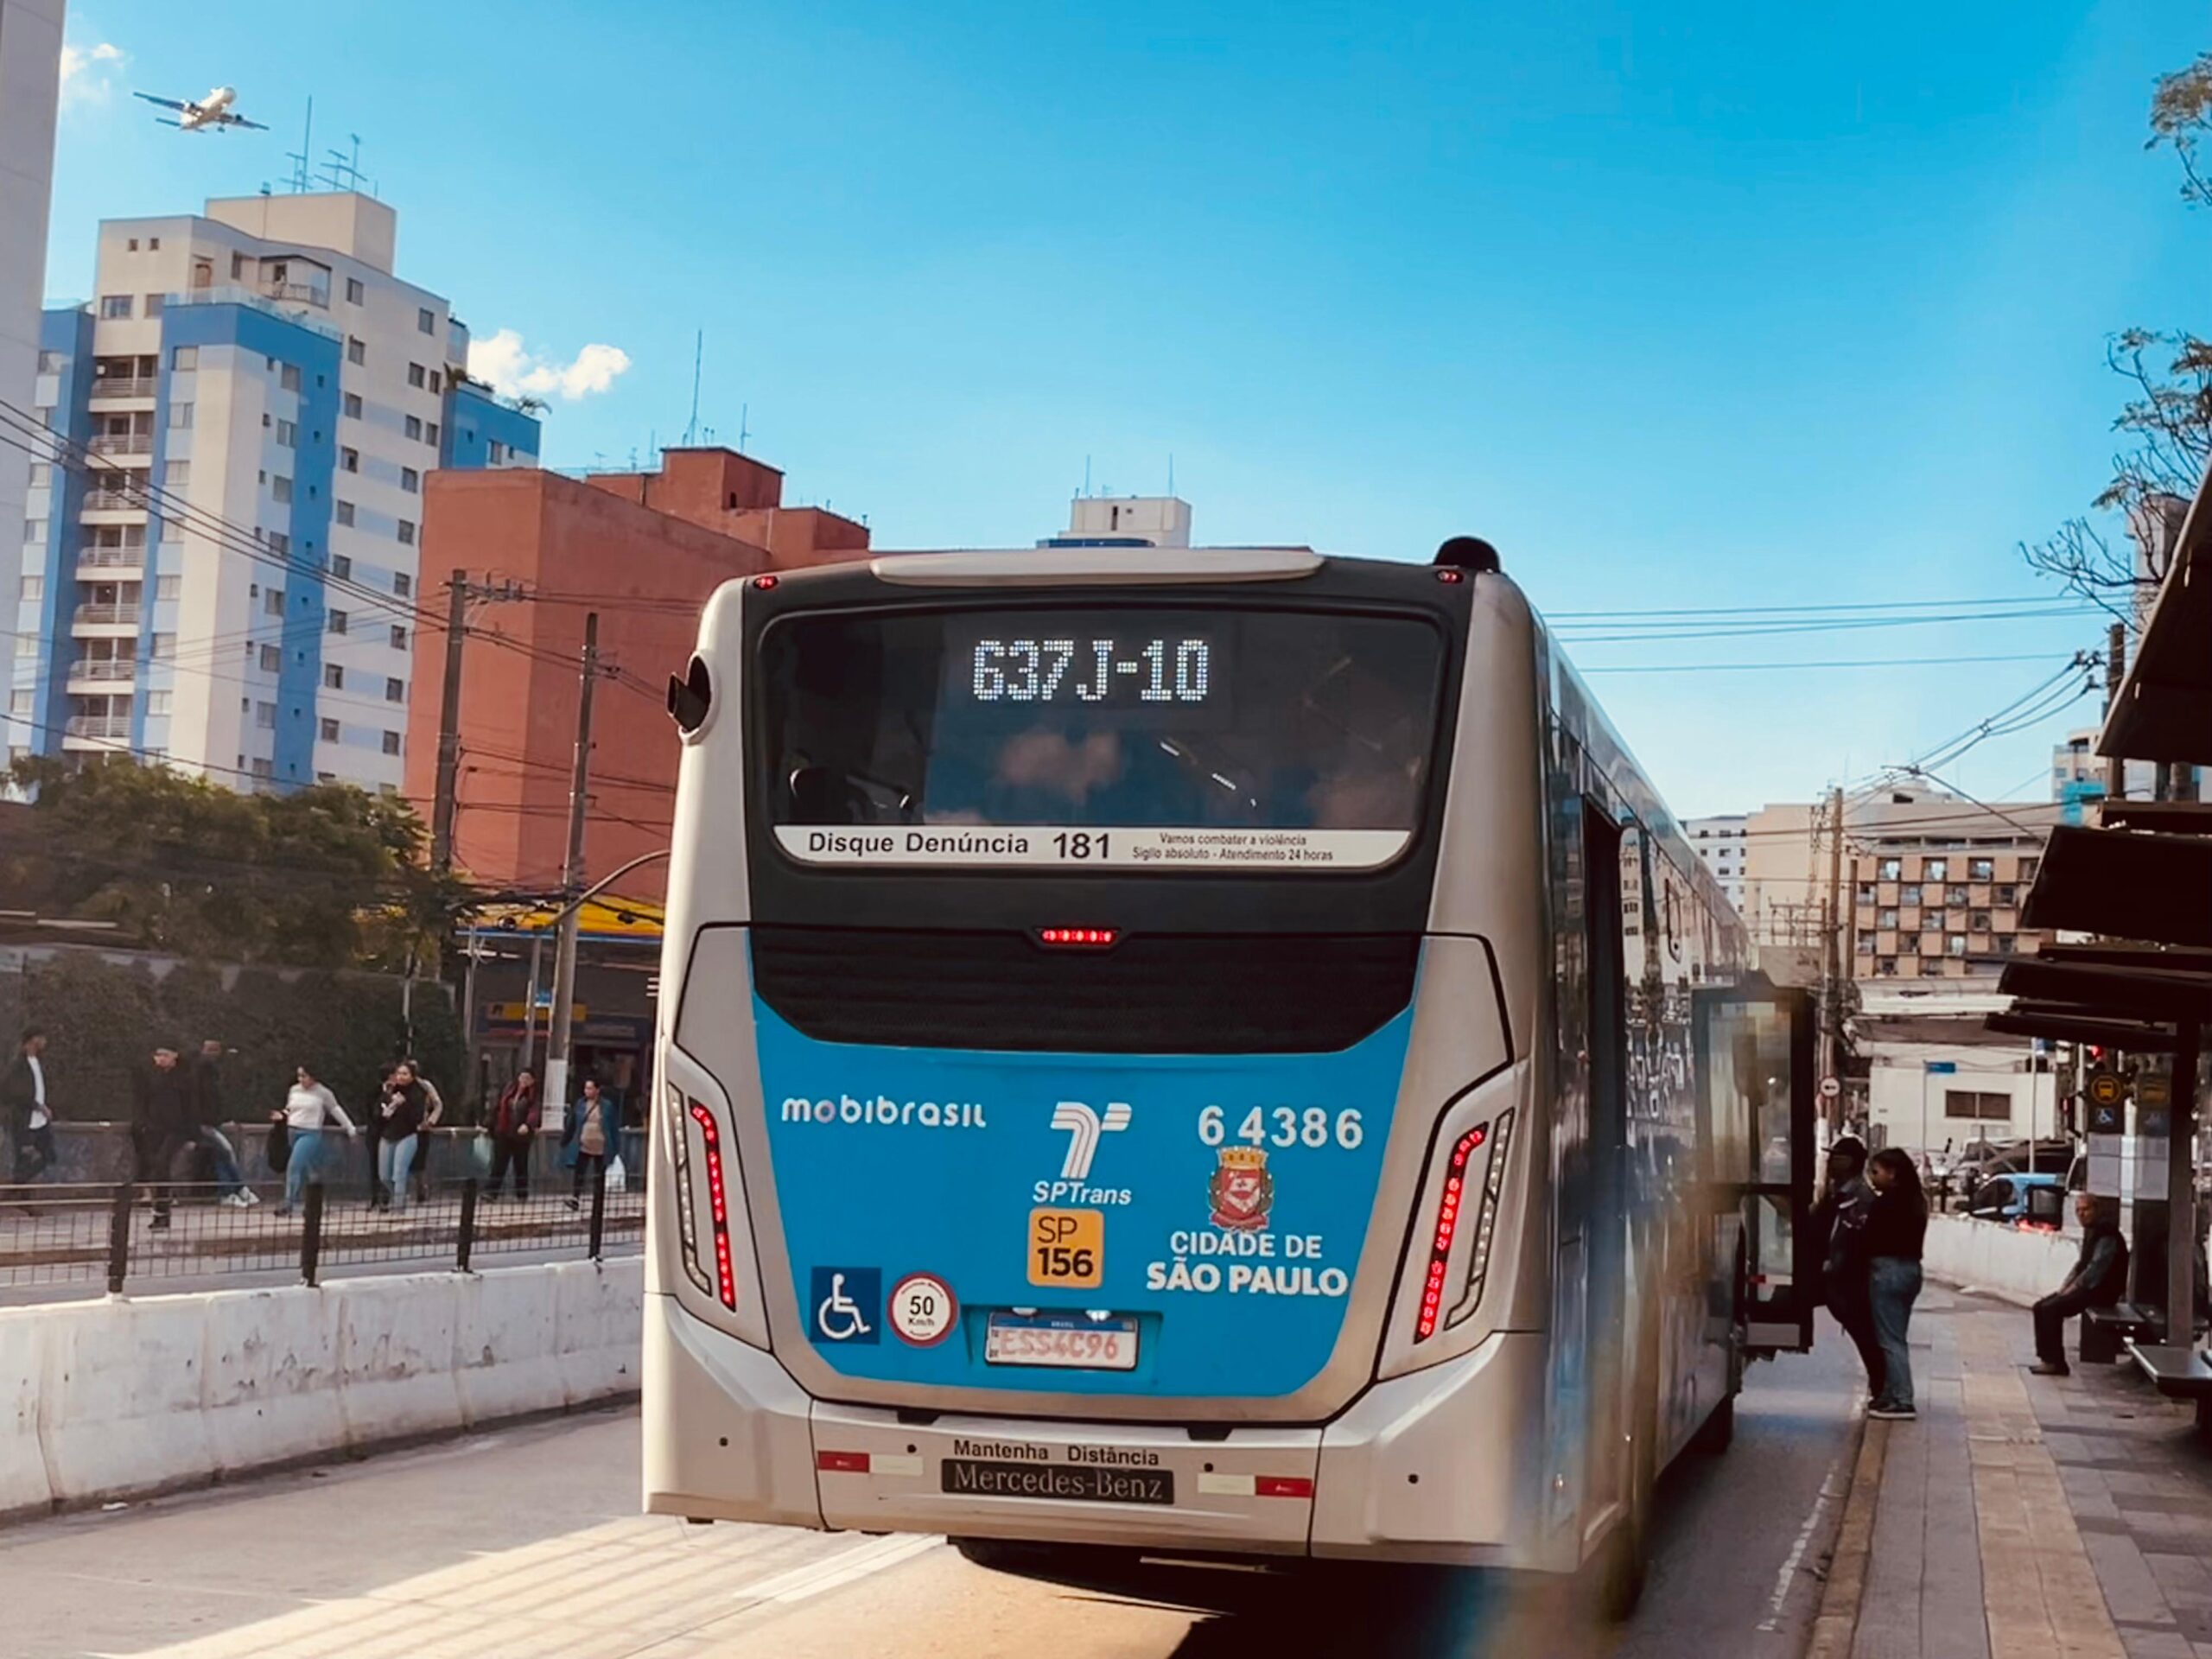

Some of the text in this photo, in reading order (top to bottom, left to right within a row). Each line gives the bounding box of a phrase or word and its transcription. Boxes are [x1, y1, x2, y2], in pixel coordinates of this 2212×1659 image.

[974, 639, 1209, 701] 637J-10
[809, 832, 1029, 857] Disque Denúncia
[1052, 832, 1111, 860] 181
[1160, 832, 1306, 846] Vamos combater a violência
[1132, 846, 1162, 861] Sigilo
[1165, 847, 1210, 860] absoluto
[1219, 848, 1287, 861] Atendimento
[1289, 849, 1300, 860] 24
[1303, 849, 1333, 861] horas
[781, 1094, 987, 1128] mobibrasil
[1033, 1180, 1132, 1205] SPTrans
[1037, 1216, 1078, 1244] SP
[1169, 1230, 1323, 1259] CIDADE DE
[1037, 1247, 1094, 1278] 156
[1146, 1256, 1349, 1297] SÃO PAULO
[909, 1295, 935, 1316] 50
[953, 1439, 1160, 1466] Mantenha Distância
[954, 1463, 1163, 1499] Mercedes-Benz
